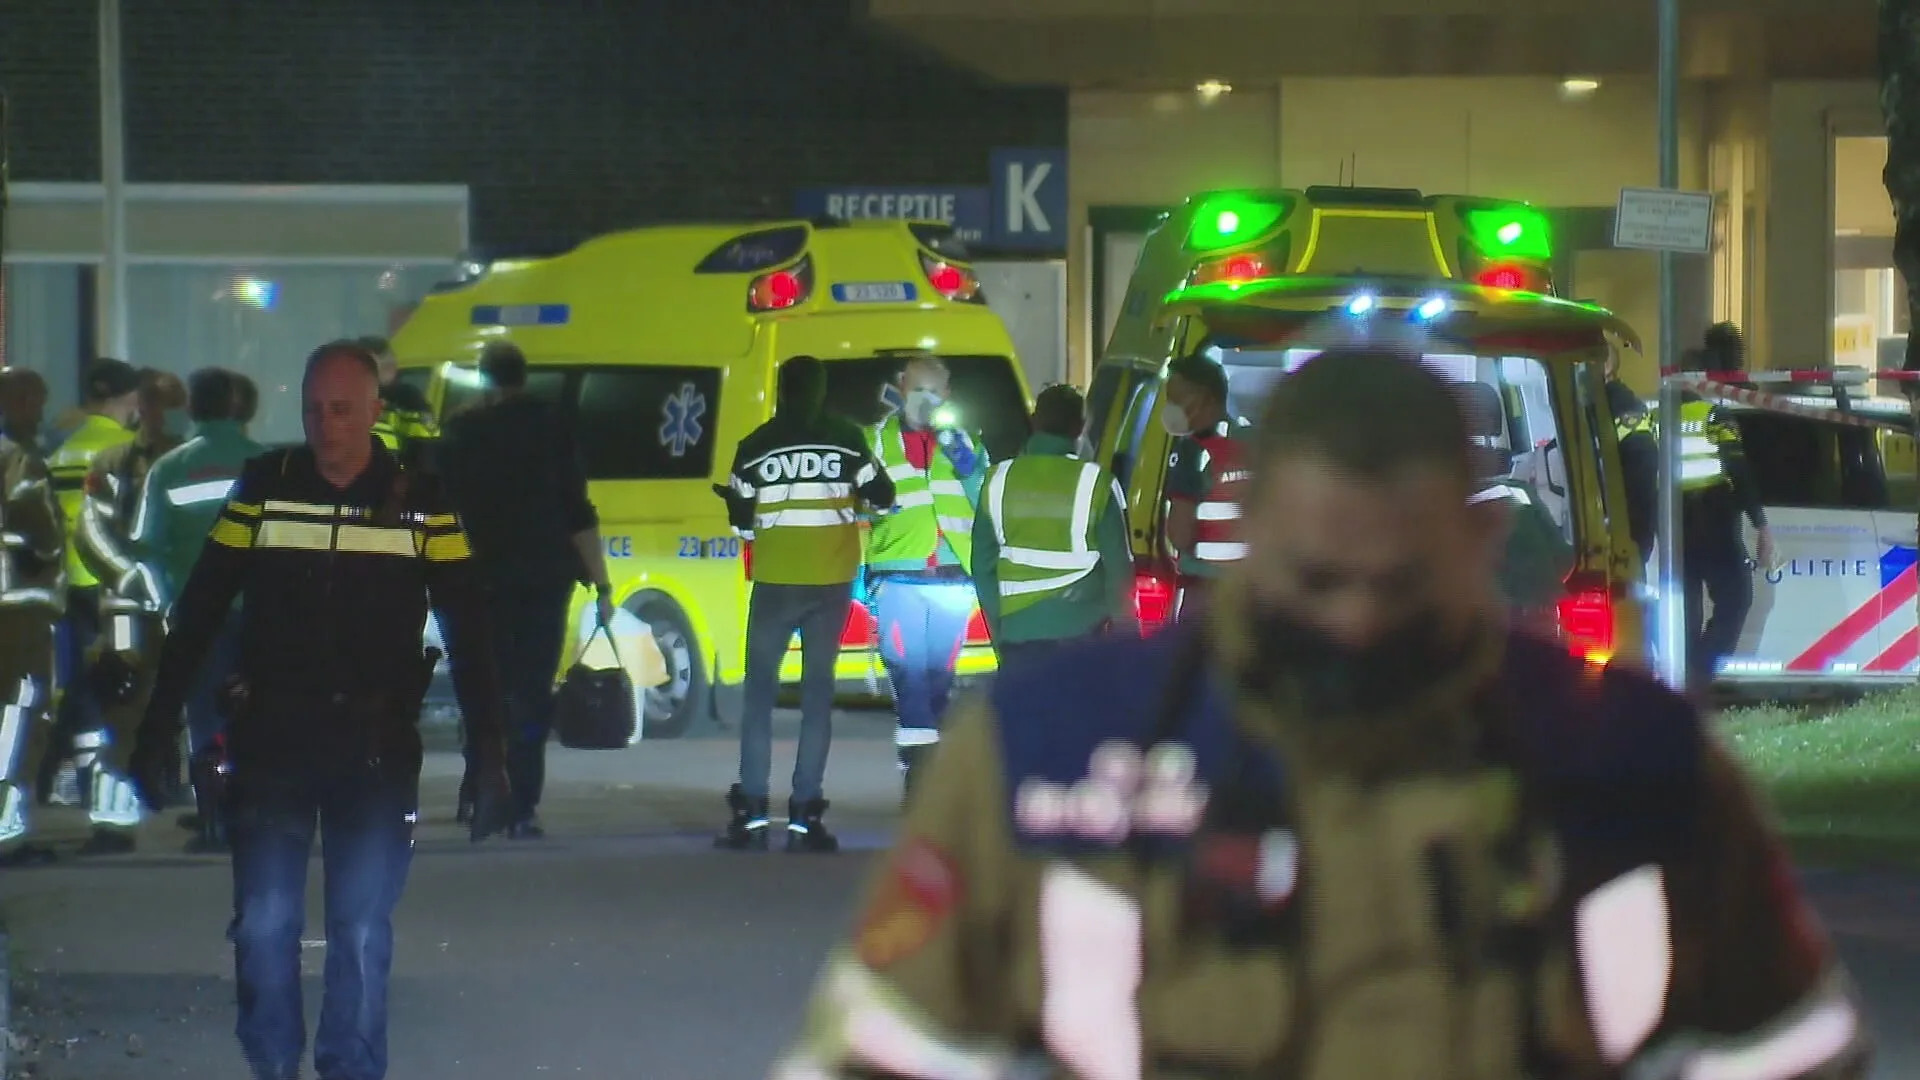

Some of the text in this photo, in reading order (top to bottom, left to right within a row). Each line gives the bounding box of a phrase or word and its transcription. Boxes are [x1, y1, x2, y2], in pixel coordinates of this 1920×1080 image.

[826, 193, 956, 221] RECEPTIE
[1008, 162, 1051, 232] K
[758, 451, 842, 483] OVDG
[601, 535, 632, 558] CE
